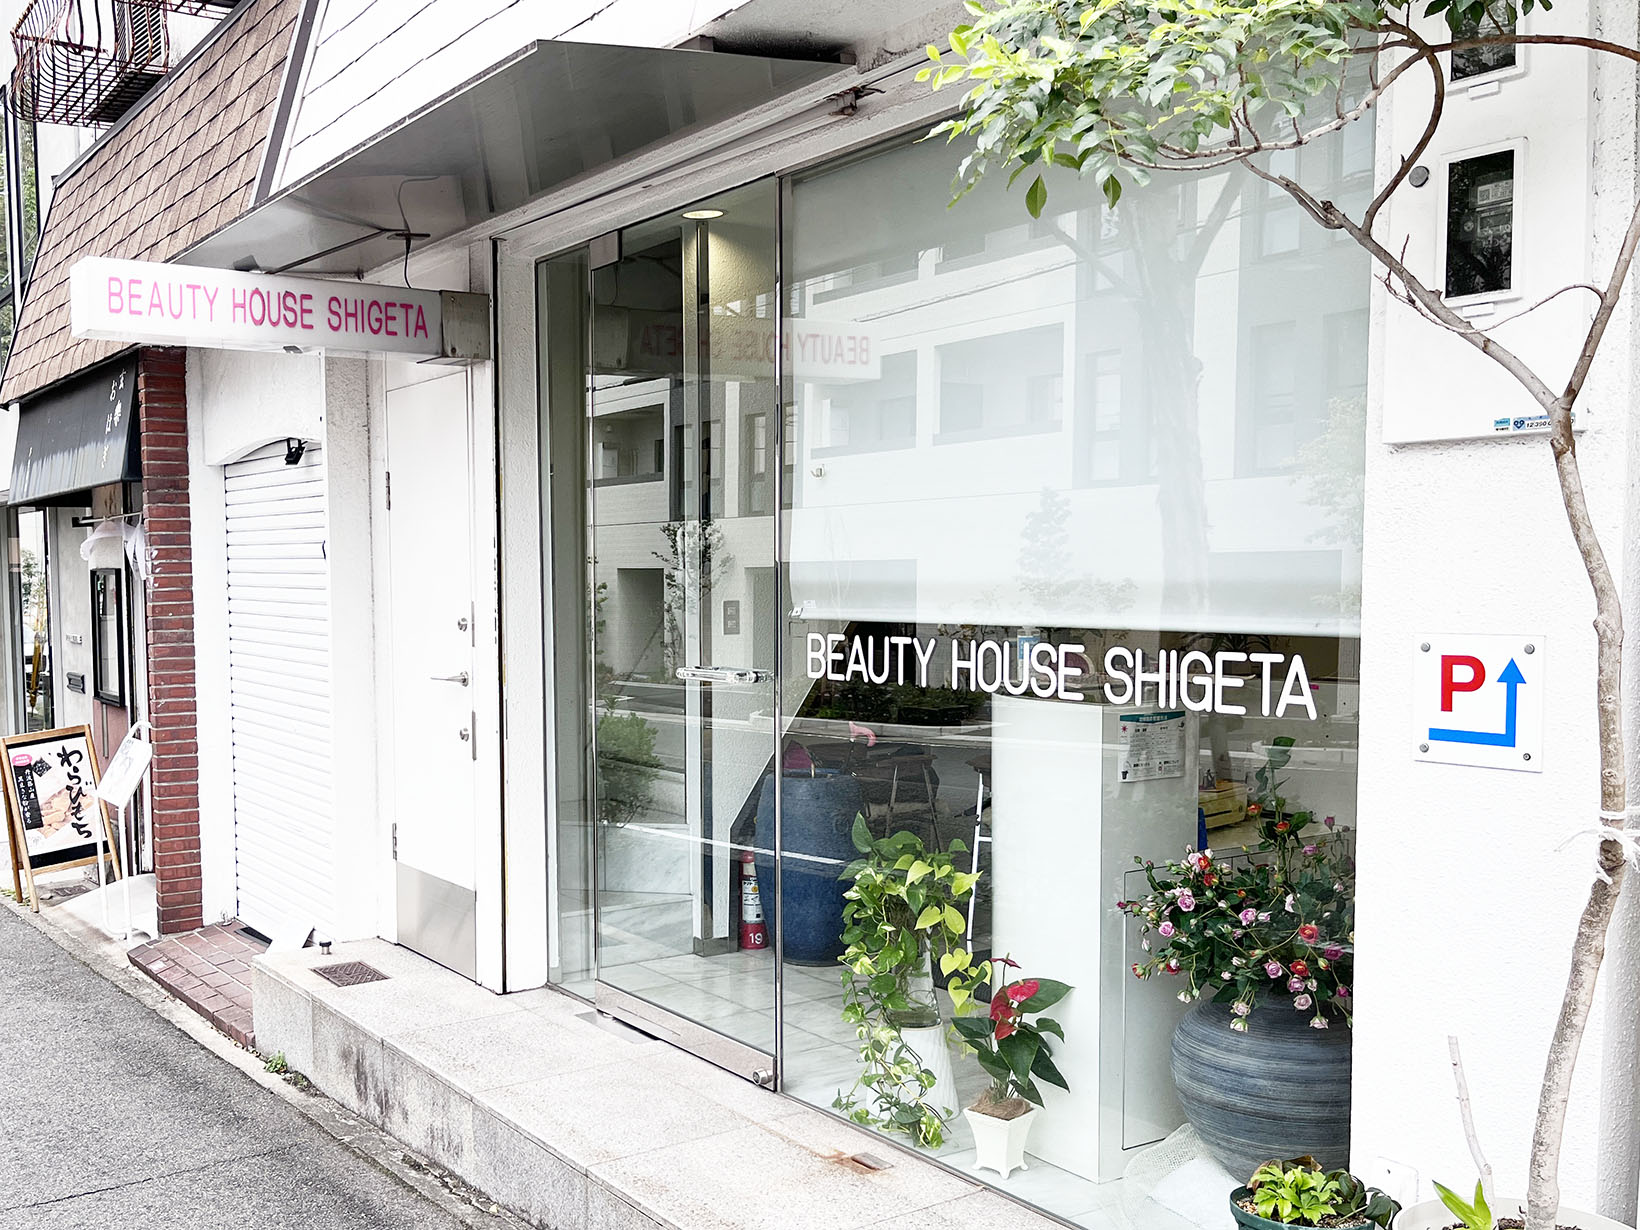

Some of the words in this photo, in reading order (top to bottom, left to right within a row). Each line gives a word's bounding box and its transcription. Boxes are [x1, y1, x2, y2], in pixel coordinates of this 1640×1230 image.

[107, 276, 219, 322] BEAUTY
[231, 288, 315, 330] HOUSE
[327, 296, 430, 340] SHIGETA
[806, 632, 936, 688] BEAUTY
[950, 639, 1085, 701] HOUSE
[1103, 646, 1318, 721] SHIGETA
[1440, 654, 1486, 712] P
[749, 933, 763, 945] 19
